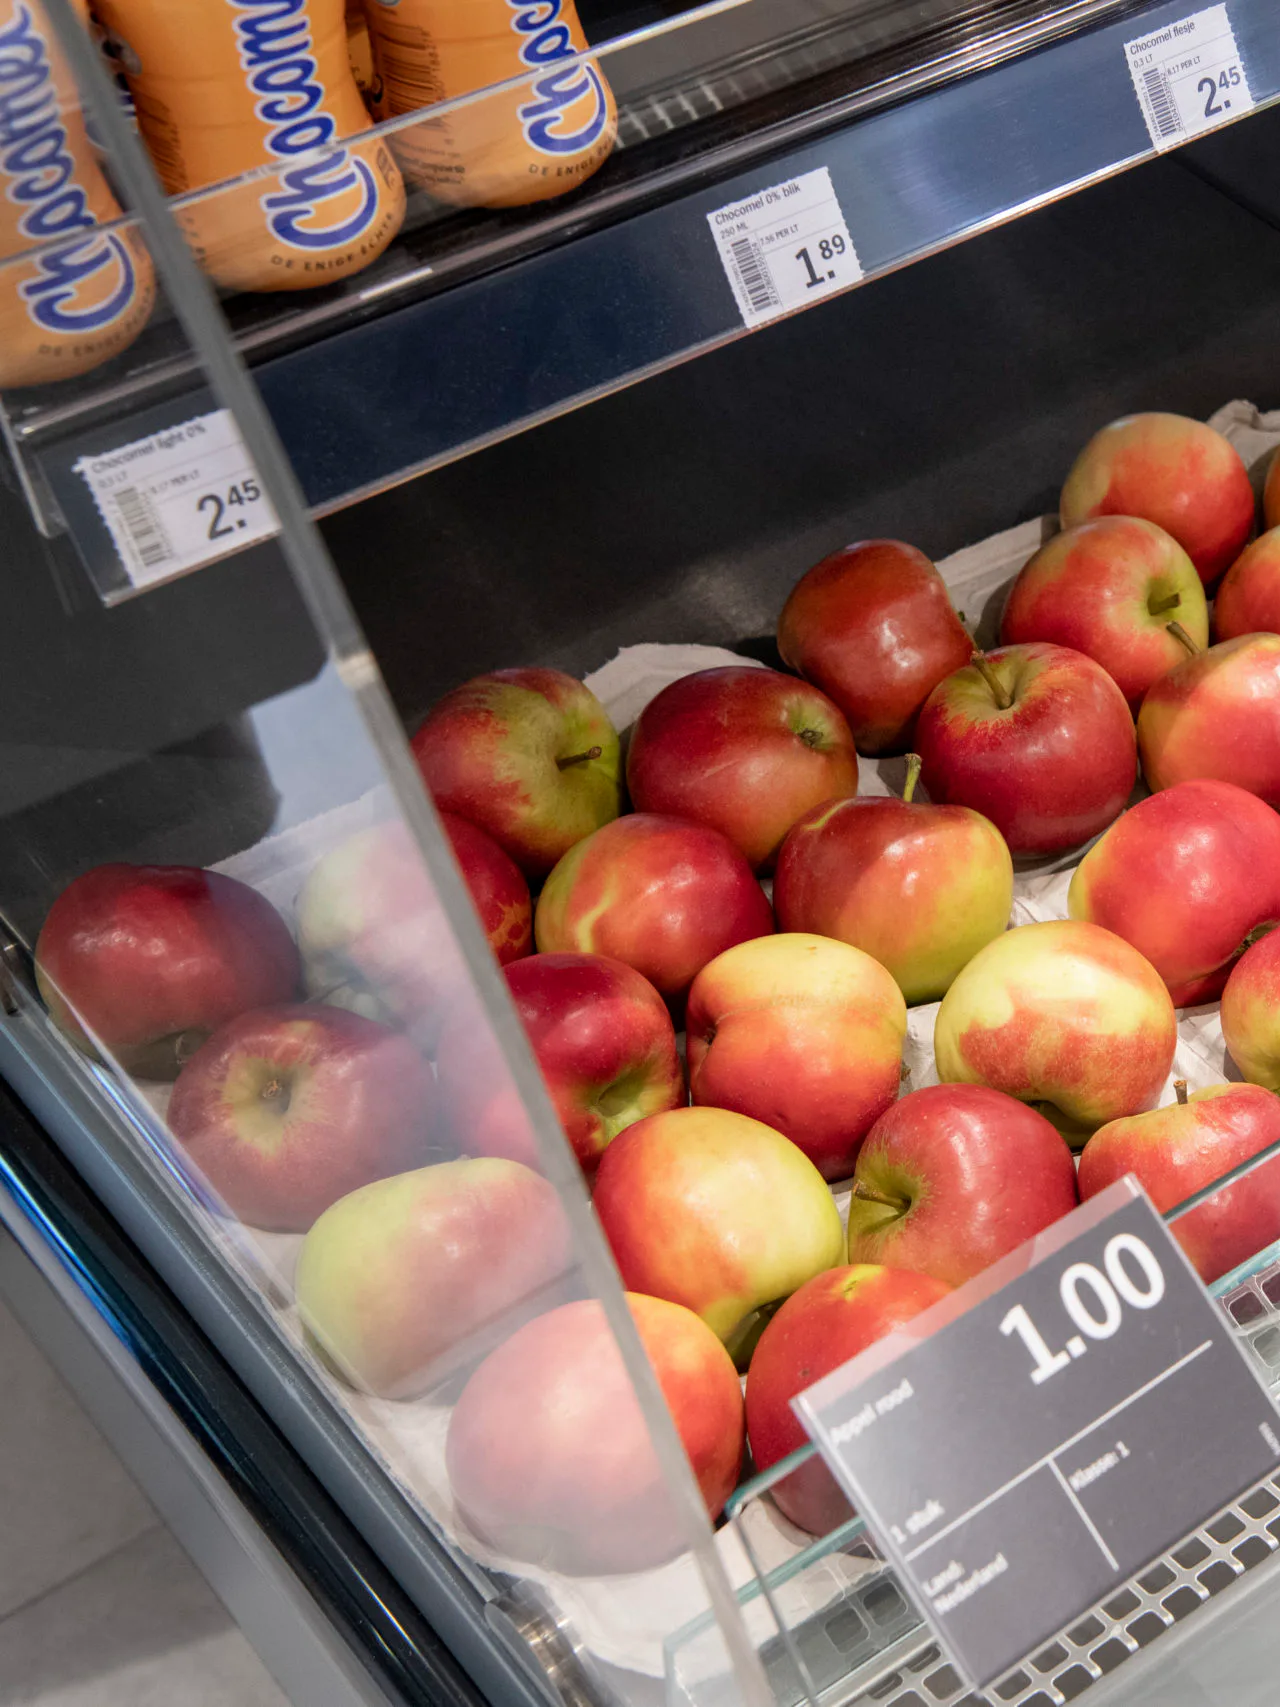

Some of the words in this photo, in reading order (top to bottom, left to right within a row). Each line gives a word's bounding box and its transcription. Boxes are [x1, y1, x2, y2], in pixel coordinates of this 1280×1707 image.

[1129, 30, 1172, 55] Chocomel
[1173, 20, 1195, 37] flesje
[1144, 53, 1153, 65] LT
[508, 0, 607, 155] Choc
[1180, 58, 1193, 71] PER
[1193, 55, 1201, 66] LT
[1197, 65, 1241, 118] 2.45
[230, 0, 377, 249] Chocom
[714, 196, 764, 226] Chocomel
[765, 190, 782, 205] 0%
[783, 182, 801, 198] blik
[719, 226, 735, 240] 250
[736, 221, 749, 233] ML
[775, 228, 790, 241] PER
[790, 223, 800, 235] LT
[795, 234, 846, 289] 1.89
[91, 440, 155, 474] Chocomel
[156, 430, 185, 451] light
[197, 479, 261, 540] 2.45
[998, 1233, 1166, 1385] 1.00
[873, 1377, 915, 1418] rood
[890, 1523, 908, 1546] 1
[904, 1498, 945, 1536] stuk
